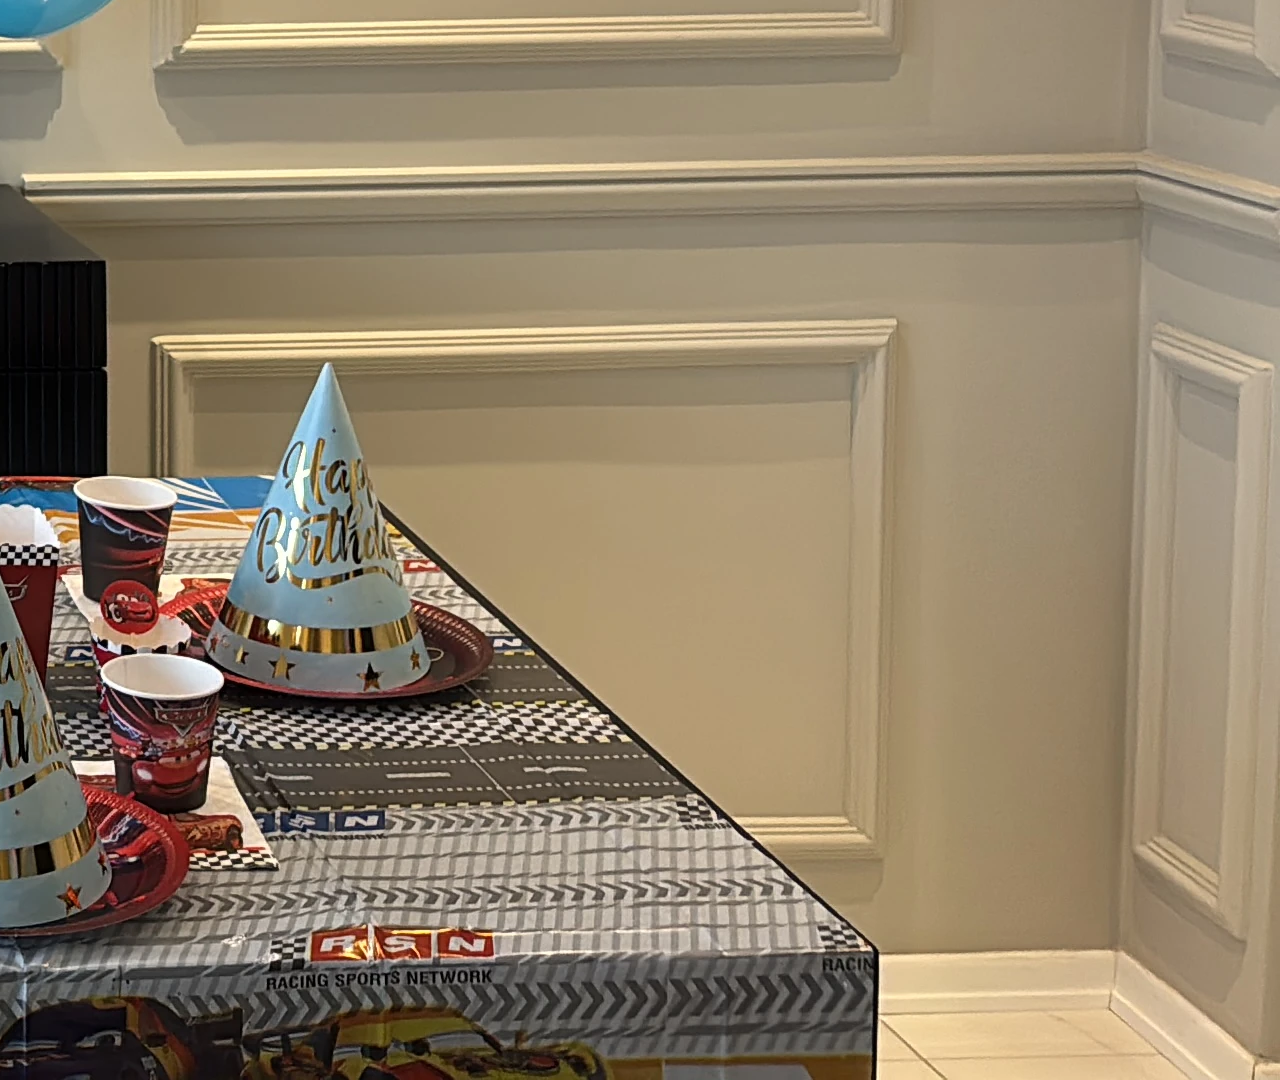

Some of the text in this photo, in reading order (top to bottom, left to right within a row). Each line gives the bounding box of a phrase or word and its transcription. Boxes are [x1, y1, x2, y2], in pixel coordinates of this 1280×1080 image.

[822, 956, 874, 971] RACIN
[266, 969, 493, 990] RACING SPORTS NETWORK
